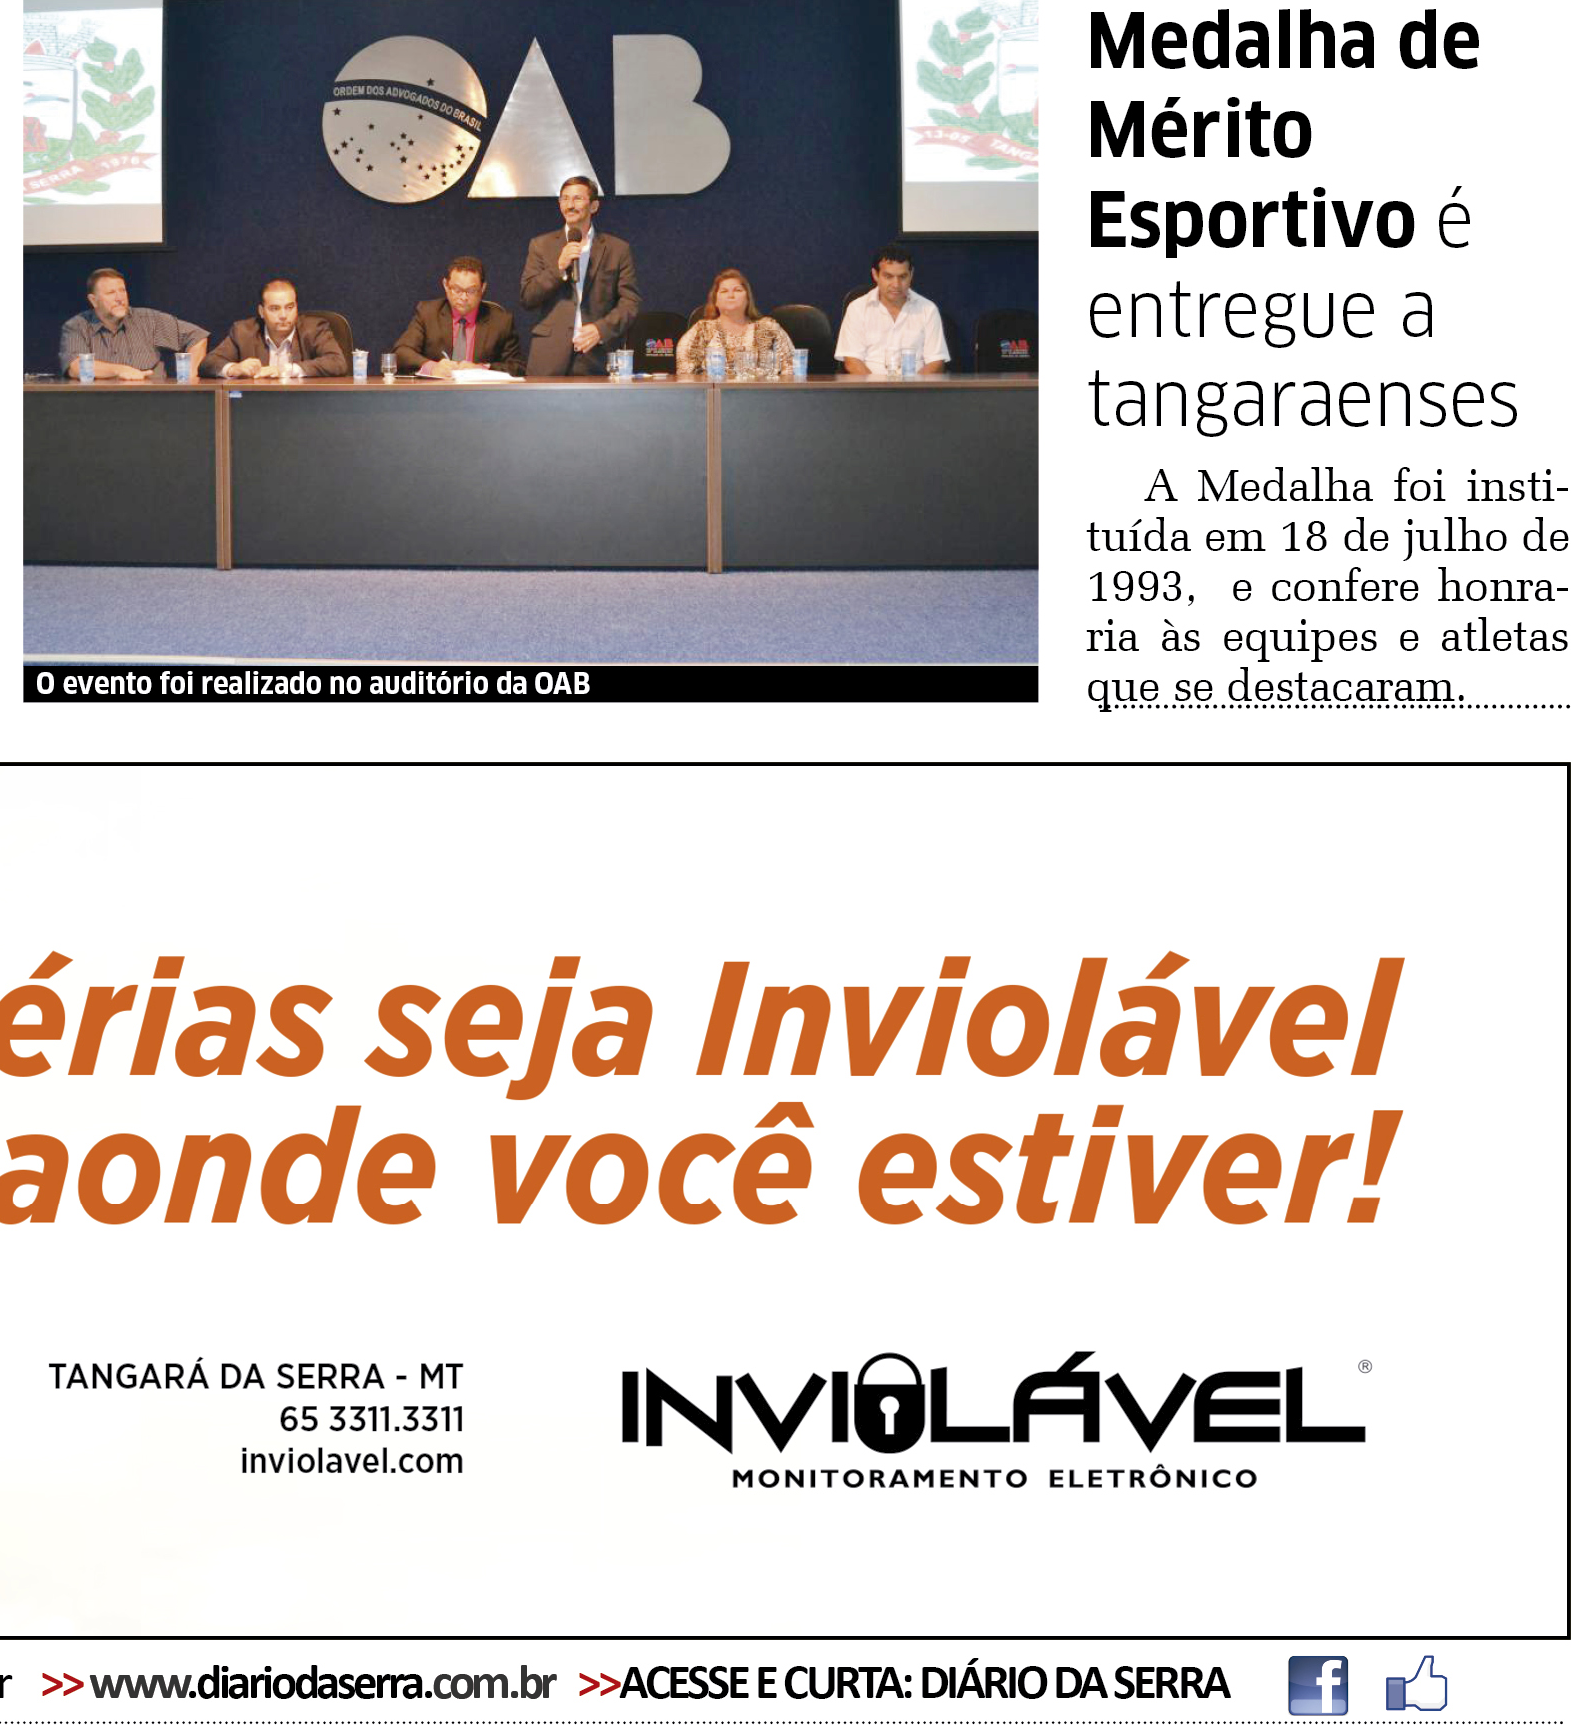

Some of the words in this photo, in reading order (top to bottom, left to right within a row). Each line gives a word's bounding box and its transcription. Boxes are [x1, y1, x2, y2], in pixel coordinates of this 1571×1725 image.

[1090, 8, 1375, 70] Medalha
[1399, 8, 1480, 70] de
[322, 34, 731, 203] OAB
[333, 86, 365, 98] ORDEM
[366, 86, 385, 97] DOS
[386, 86, 439, 111] ADVOGADOS
[440, 103, 453, 116] DO
[452, 108, 482, 133] BRASIL
[1090, 96, 1312, 159] Mérito
[1090, 186, 1415, 259] Esportivo
[1438, 185, 1471, 249] é
[1089, 280, 1375, 349] entregue
[1402, 291, 1433, 338] a
[1087, 369, 1518, 438] tangaraenses
[363, 955, 654, 1101] seja
[695, 950, 1406, 1078] Inviolável
[489, 1095, 815, 1226] você
[857, 1104, 1404, 1226] estiver!
[241, 1446, 463, 1474] inviolavel.com
[732, 1468, 1028, 1489] MONITORAMENTO
[1049, 1463, 1258, 1489] ELETRÔNICO
[89, 1664, 558, 1700] www.diariodaserra.com.br
